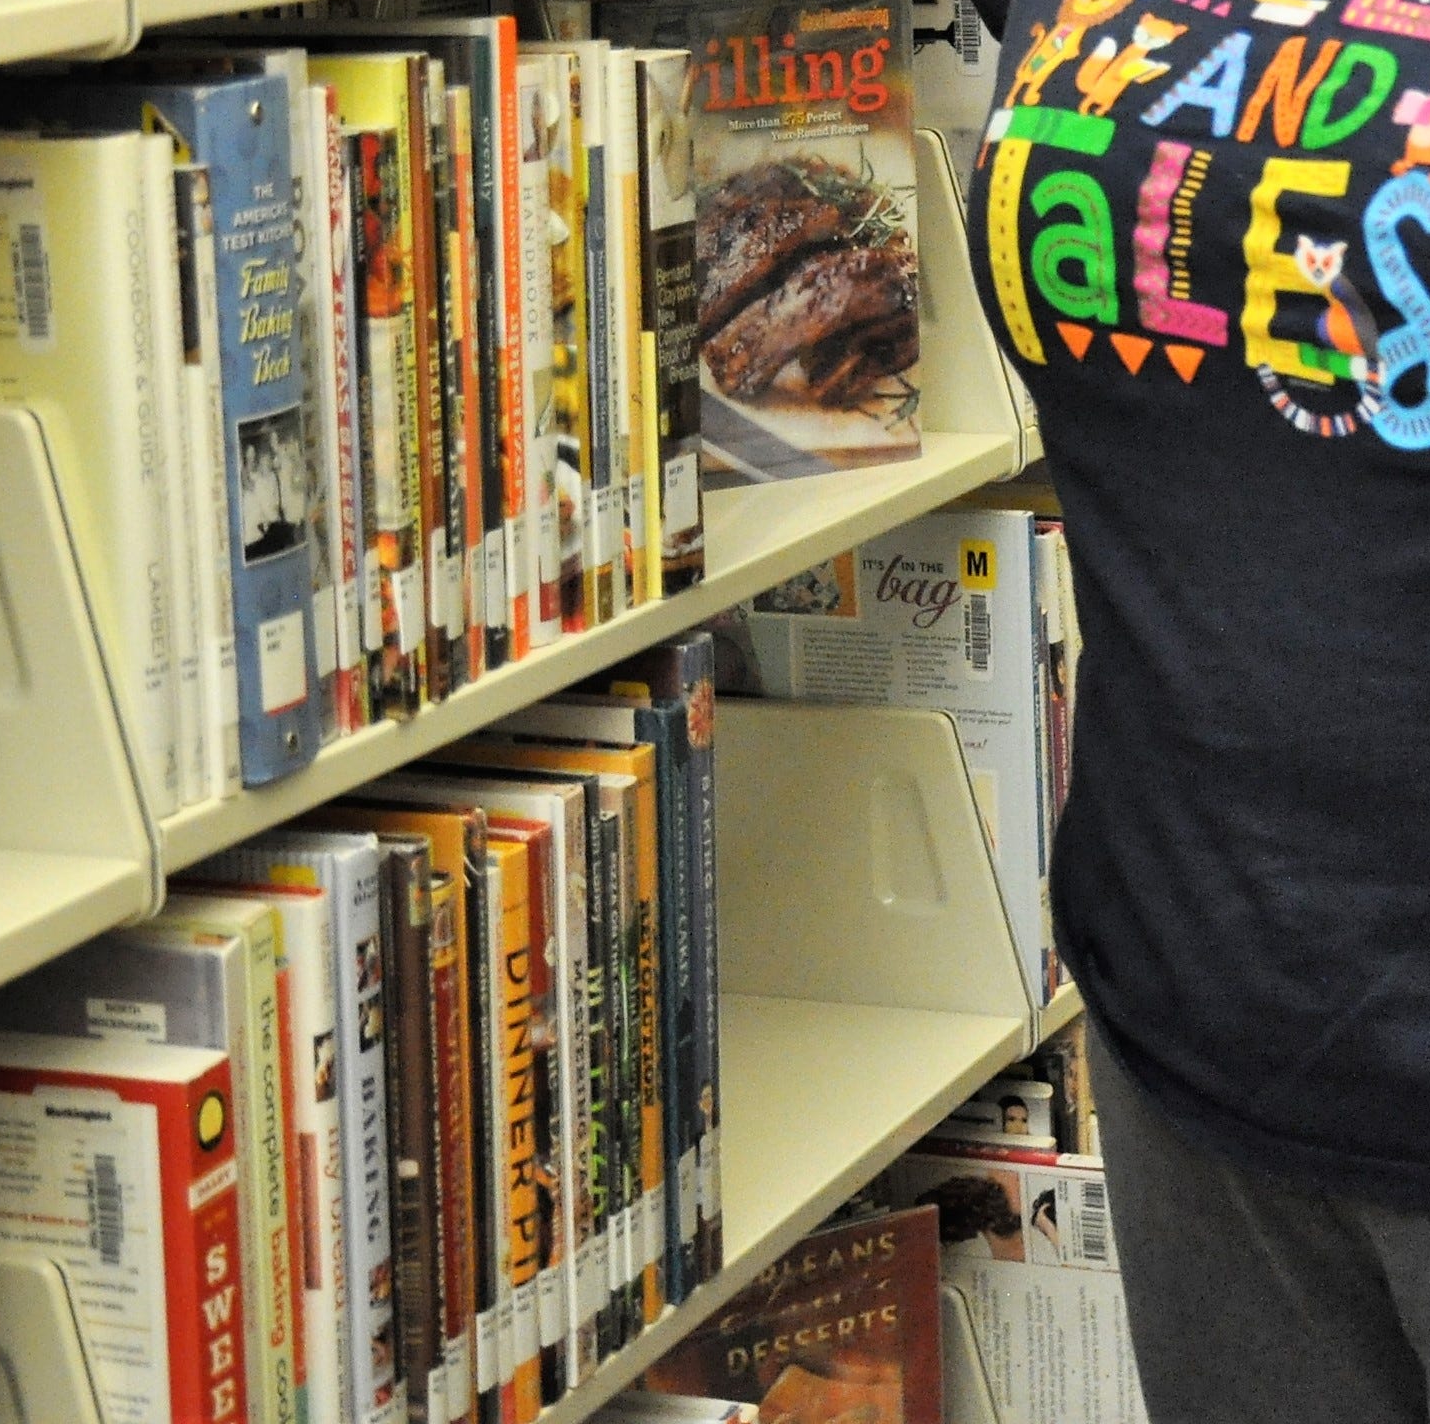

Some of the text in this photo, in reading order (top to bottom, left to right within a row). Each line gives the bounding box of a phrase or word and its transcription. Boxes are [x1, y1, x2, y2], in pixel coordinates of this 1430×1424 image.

[727, 110, 843, 130] More than 275 Perfect
[1139, 32, 1399, 150] AND
[478, 116, 494, 205] ovenly
[770, 123, 869, 142] Year-Round Recipes
[240, 259, 291, 301] Family
[521, 186, 539, 345] HANDBOOK
[240, 303, 294, 346] Baking
[428, 343, 442, 421] TEXAS
[394, 333, 409, 512] SHEET PAN SUPPERS
[430, 429, 444, 476] BBQ
[861, 559, 944, 575] IT'S IN THE
[875, 554, 962, 630] bag
[967, 550, 989, 578] M
[638, 898, 657, 1108] REVOLUTION
[505, 948, 537, 1188] DINNER
[572, 959, 589, 1142] MASTERING
[258, 996, 292, 1349] the complete baking
[726, 1303, 898, 1377] DESSERTS
